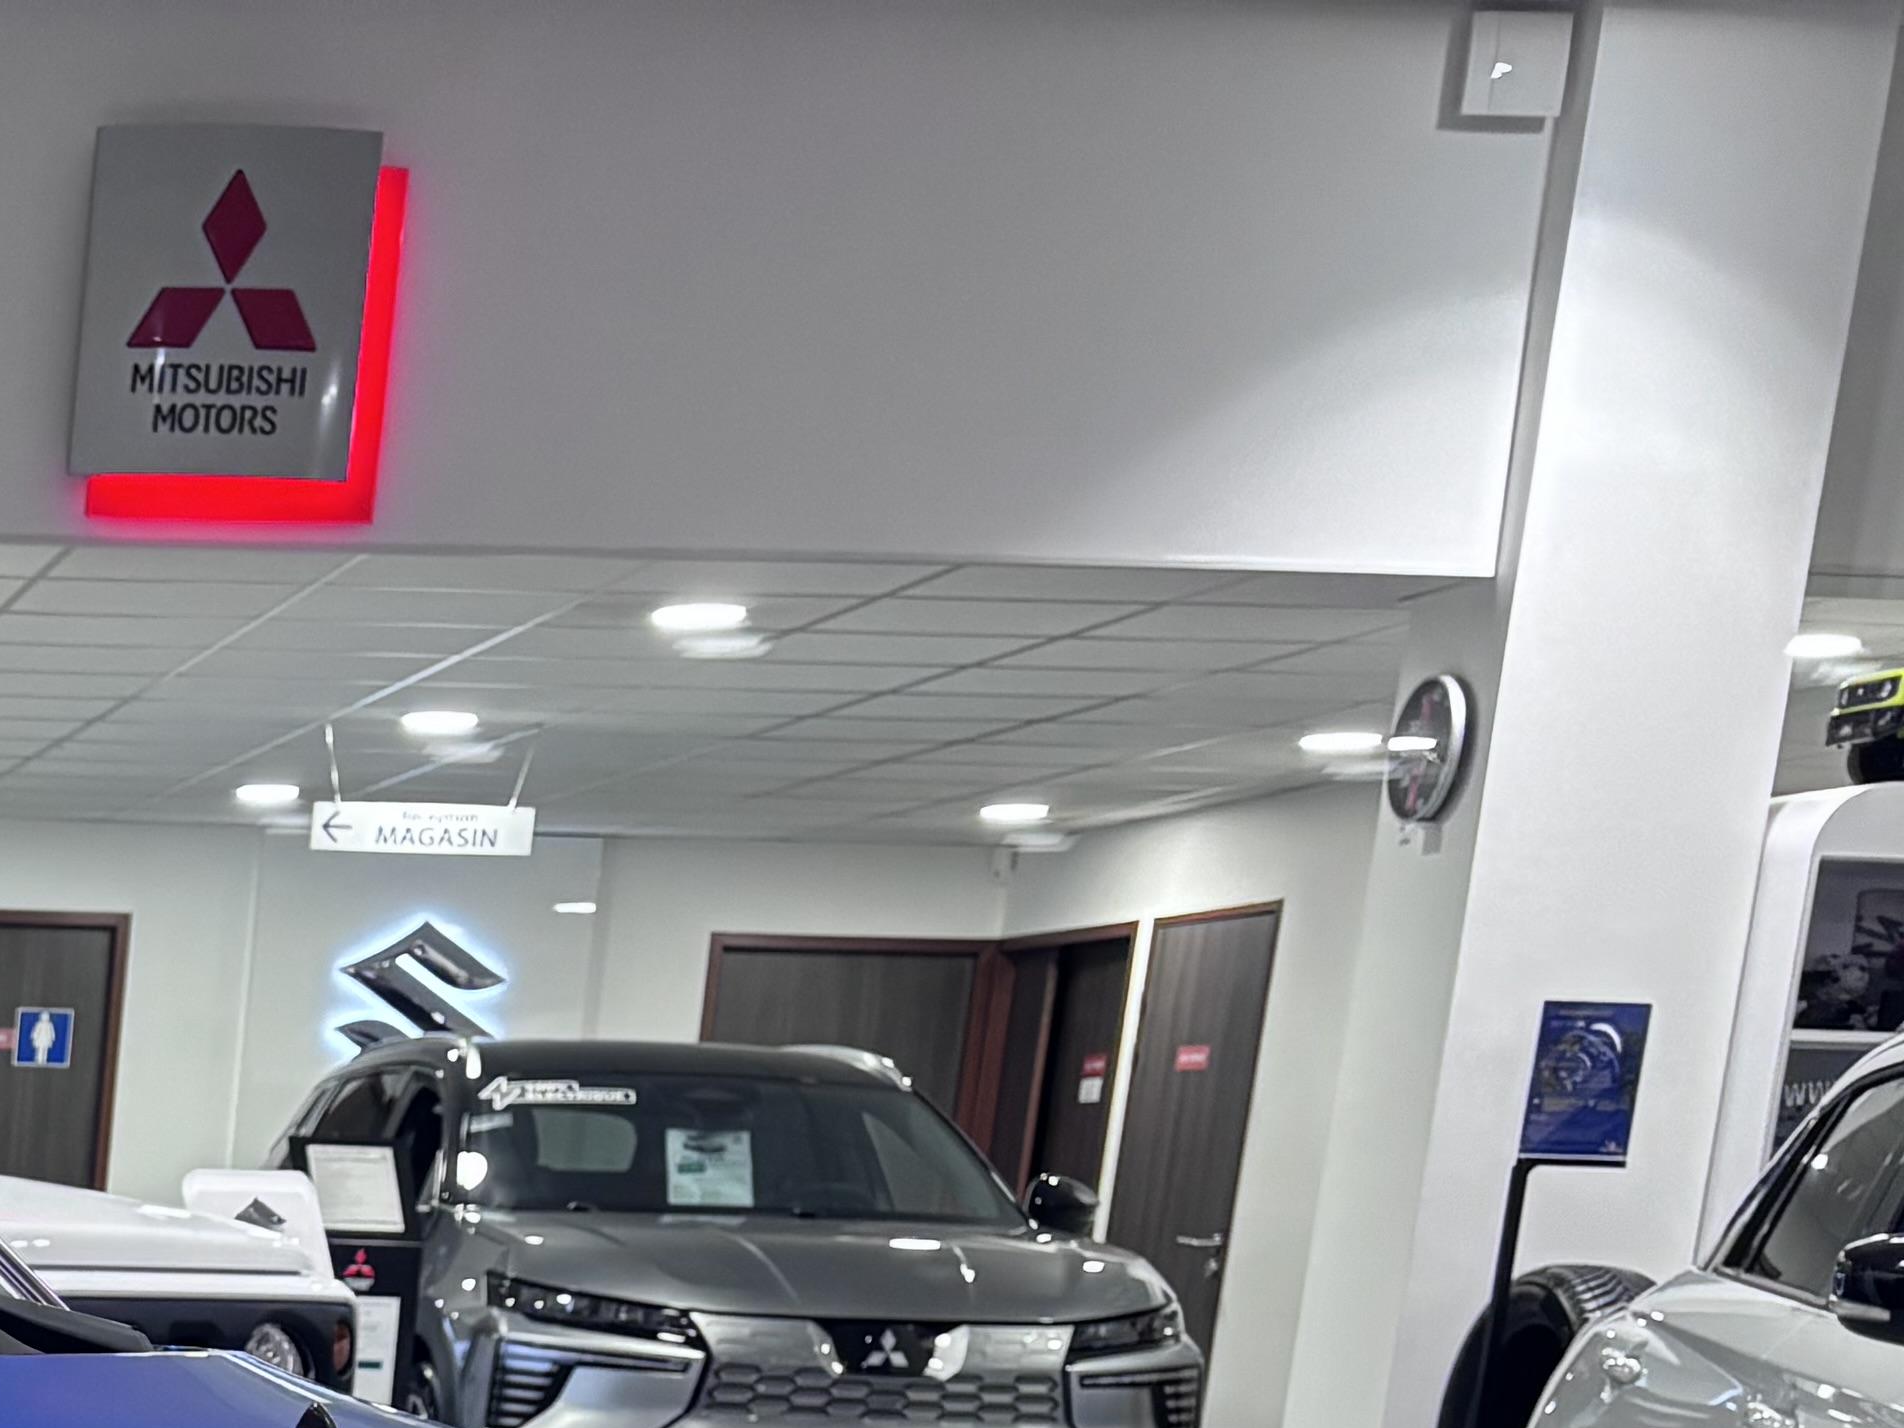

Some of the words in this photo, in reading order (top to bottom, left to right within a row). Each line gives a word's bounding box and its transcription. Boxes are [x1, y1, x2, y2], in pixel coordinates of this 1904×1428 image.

[131, 363, 307, 397] MITSUBISHI
[152, 404, 277, 435] MOTORS
[375, 825, 499, 848] MAGASIN
